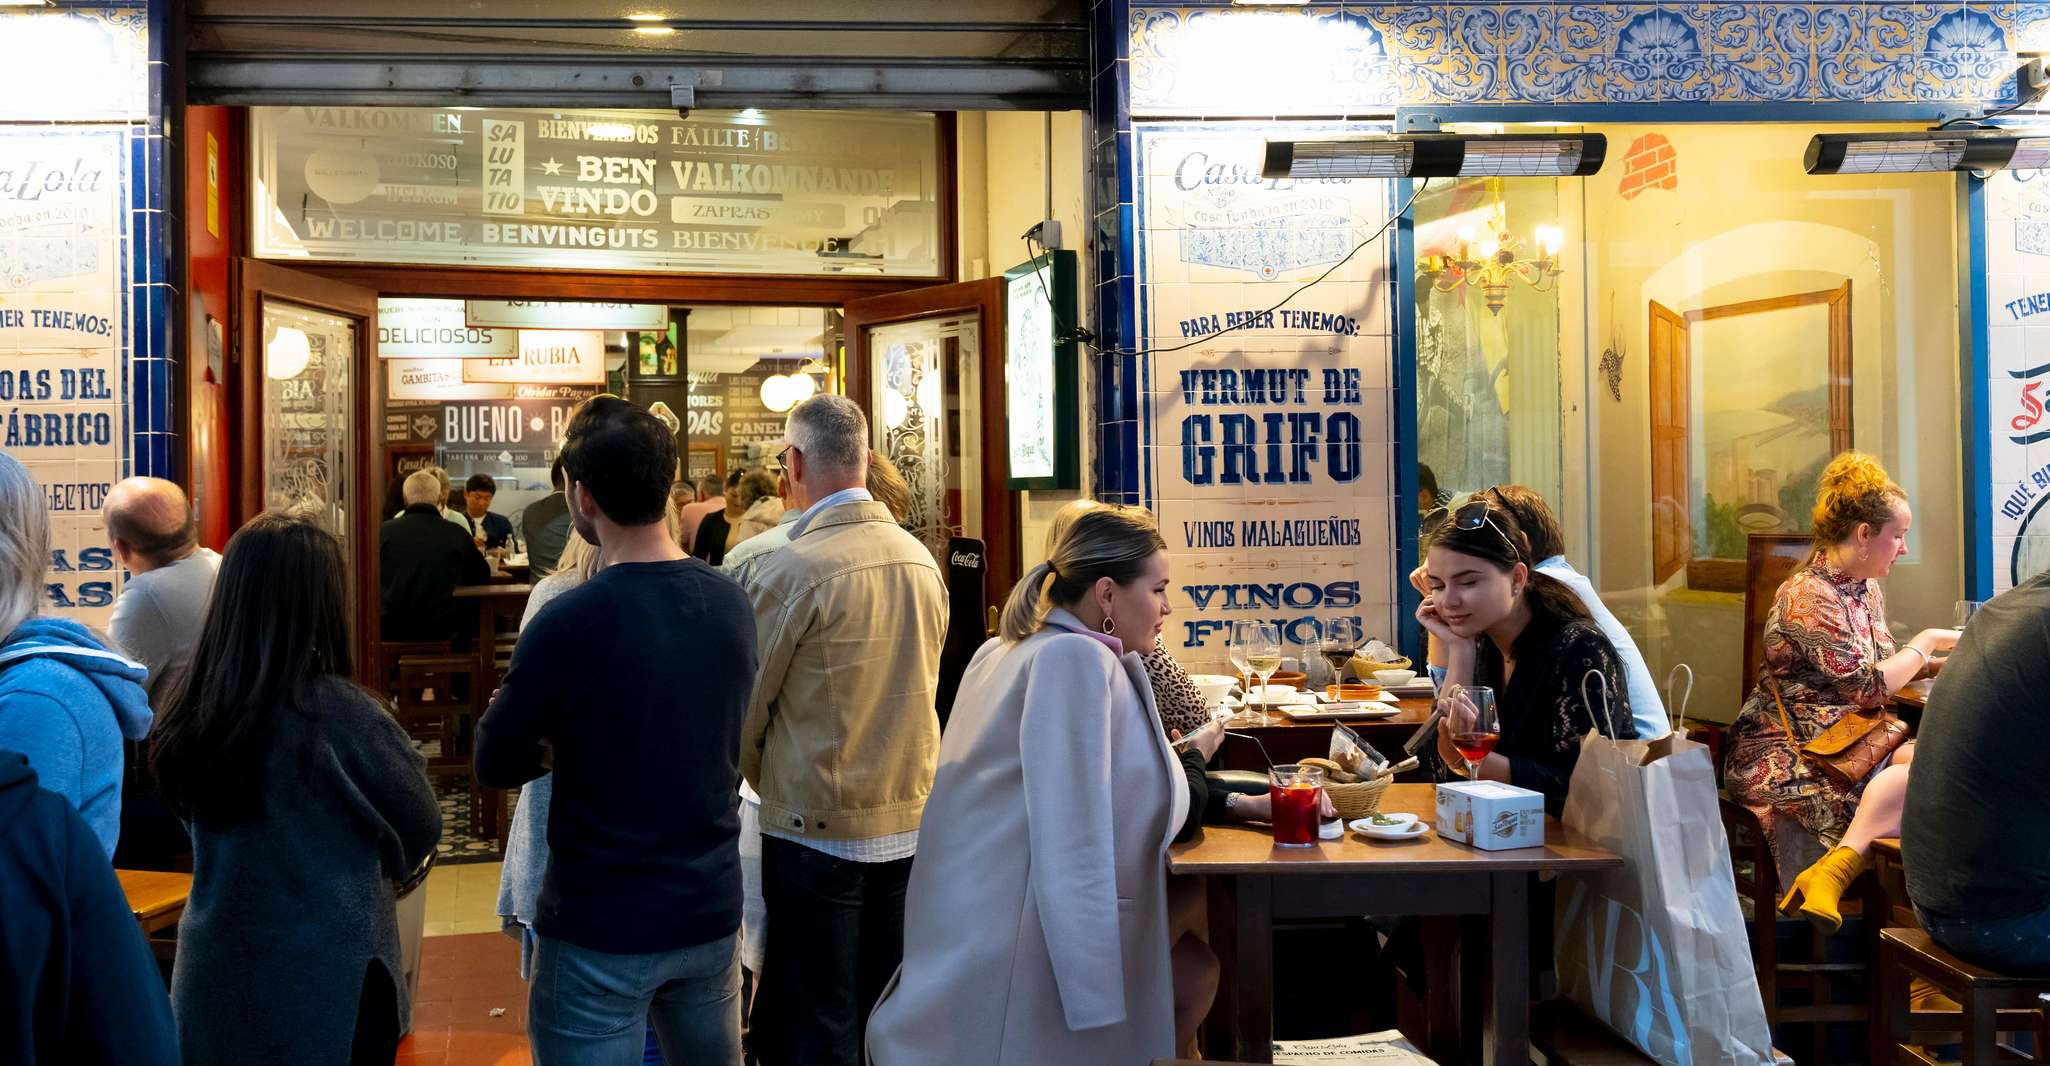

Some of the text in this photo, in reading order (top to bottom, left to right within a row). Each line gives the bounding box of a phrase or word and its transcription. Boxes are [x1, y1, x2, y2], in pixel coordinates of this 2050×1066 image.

[489, 124, 517, 142] SA
[488, 147, 515, 165] LU
[489, 168, 512, 187] TA
[577, 156, 656, 185] BEN
[488, 191, 520, 210] TIO
[537, 186, 658, 216] VINDO
[306, 217, 462, 242] WELCOME
[482, 224, 659, 248] BENVINGUTS
[2006, 293, 2050, 320] TENE
[0, 309, 112, 337] ER TENEMOS:
[378, 328, 492, 344] DELICIOSOS
[1180, 314, 1221, 338] PARA
[1280, 310, 1361, 337] TENEMOS:
[524, 347, 581, 367] RUBIA
[60, 368, 111, 400] DEL
[1179, 367, 1363, 405] VERMUT DE
[0, 407, 110, 447] ÁBRICO
[445, 405, 522, 443] BUENO
[1181, 411, 1362, 486] GRIFO
[1184, 515, 1361, 549] VINOS MALAGUEÑOS
[1182, 581, 1361, 611] VINOS
[1183, 616, 1363, 648] FINOS
